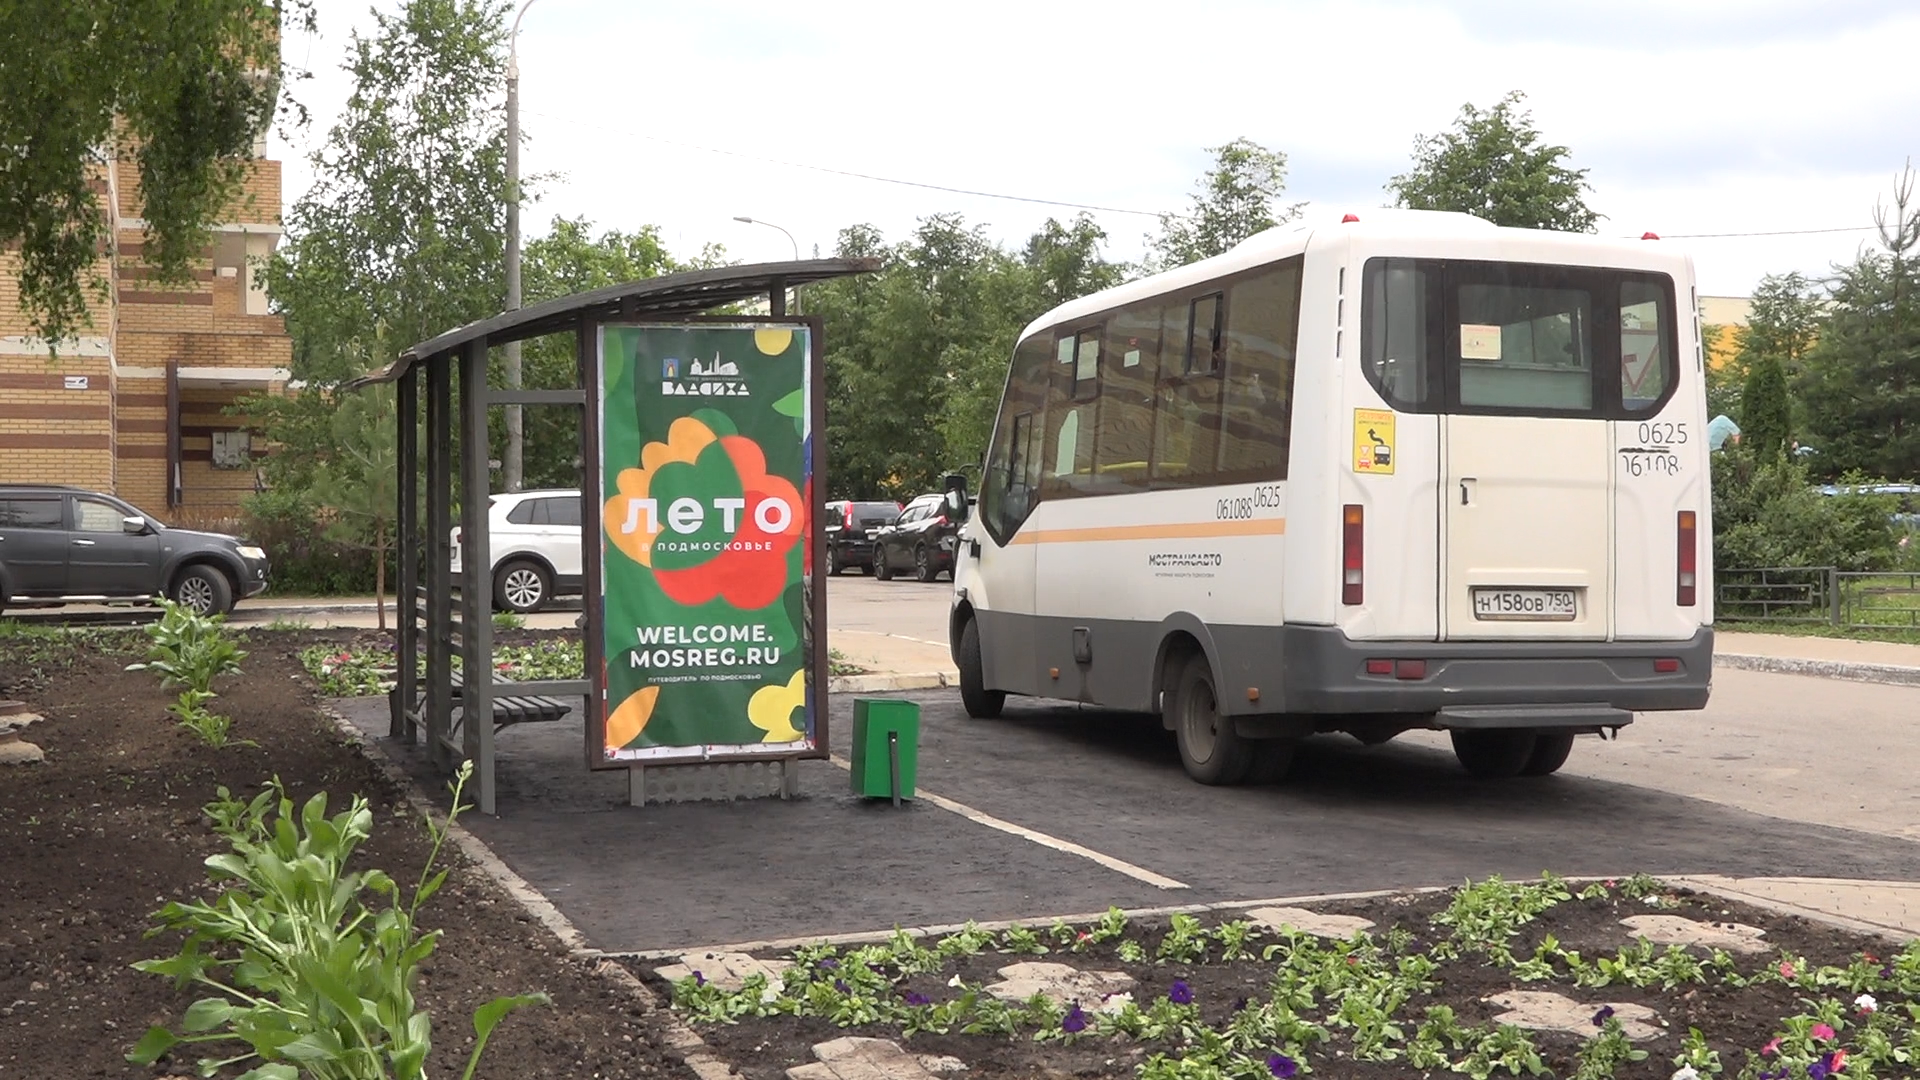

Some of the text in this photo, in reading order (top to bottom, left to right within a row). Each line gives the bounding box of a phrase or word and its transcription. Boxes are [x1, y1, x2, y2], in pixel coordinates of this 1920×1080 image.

[662, 381, 750, 396] ВЛАСИХА
[1639, 422, 1688, 444] 0625
[1216, 486, 1281, 519] 061088 0625
[621, 497, 792, 534] лето
[657, 541, 772, 552] ПОДМОСКОВЬЕ
[1148, 553, 1222, 566] МОСТРАНСАВТО
[636, 624, 774, 645] WELCOME.
[630, 647, 780, 668] MOSREG.RU
